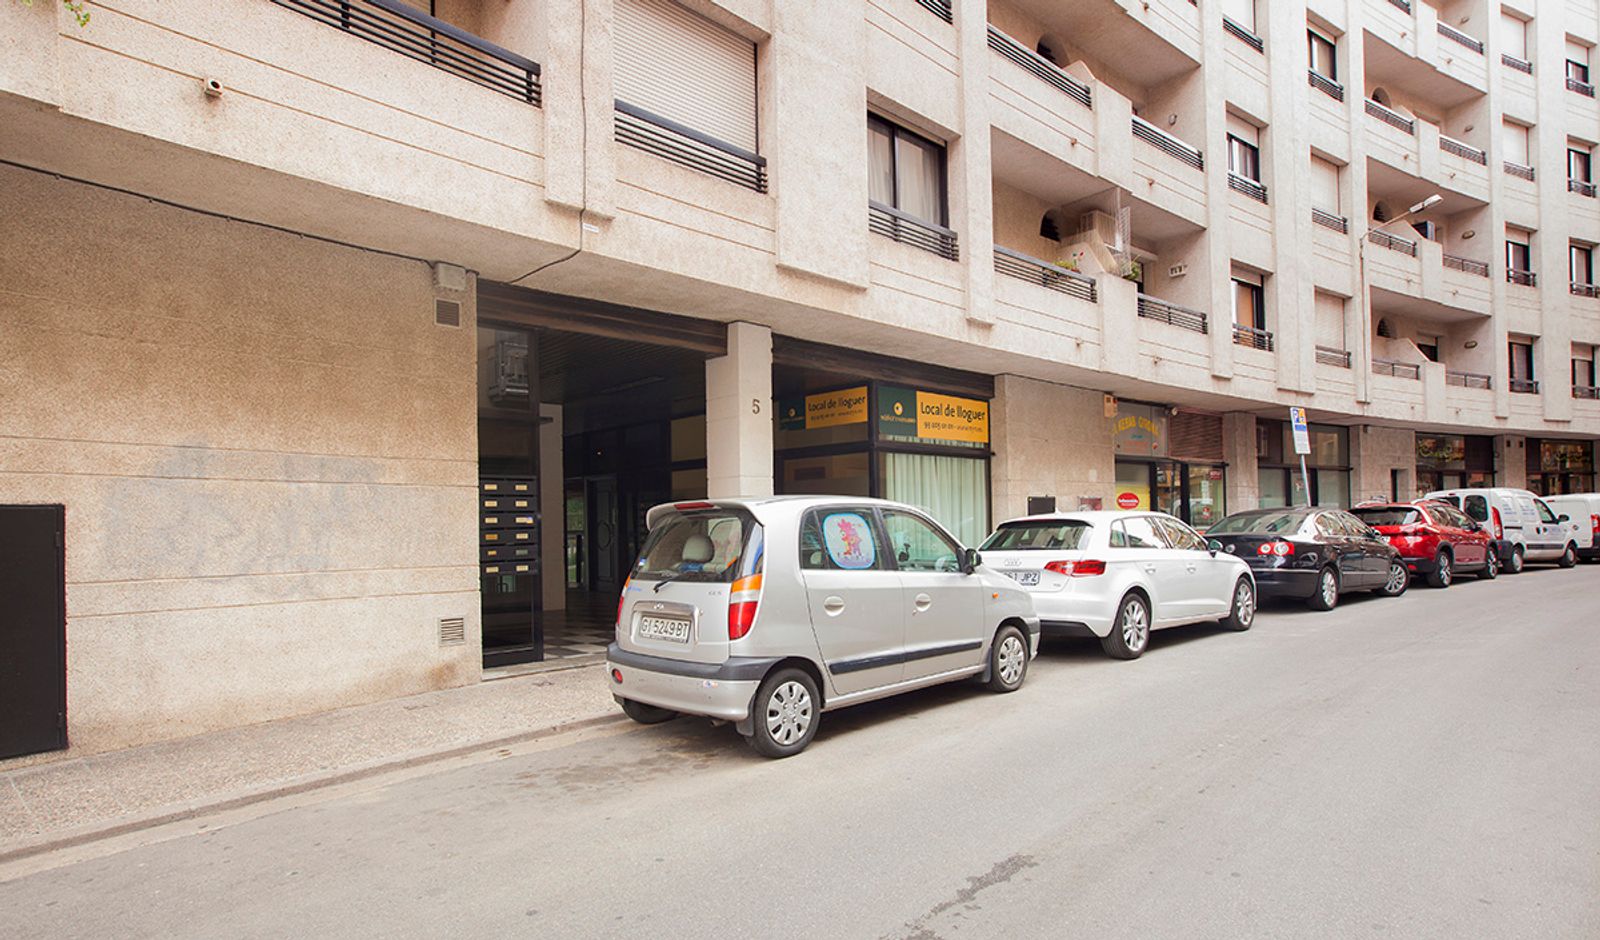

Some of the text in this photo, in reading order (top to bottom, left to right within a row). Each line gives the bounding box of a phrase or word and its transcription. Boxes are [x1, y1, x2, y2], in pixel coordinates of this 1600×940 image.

[752, 399, 760, 414] 5
[809, 396, 865, 412] Local de lloguer
[921, 402, 986, 422] Local de lloguer
[1020, 573, 1037, 582] JPZ
[641, 618, 689, 638] GI 5249 BT
